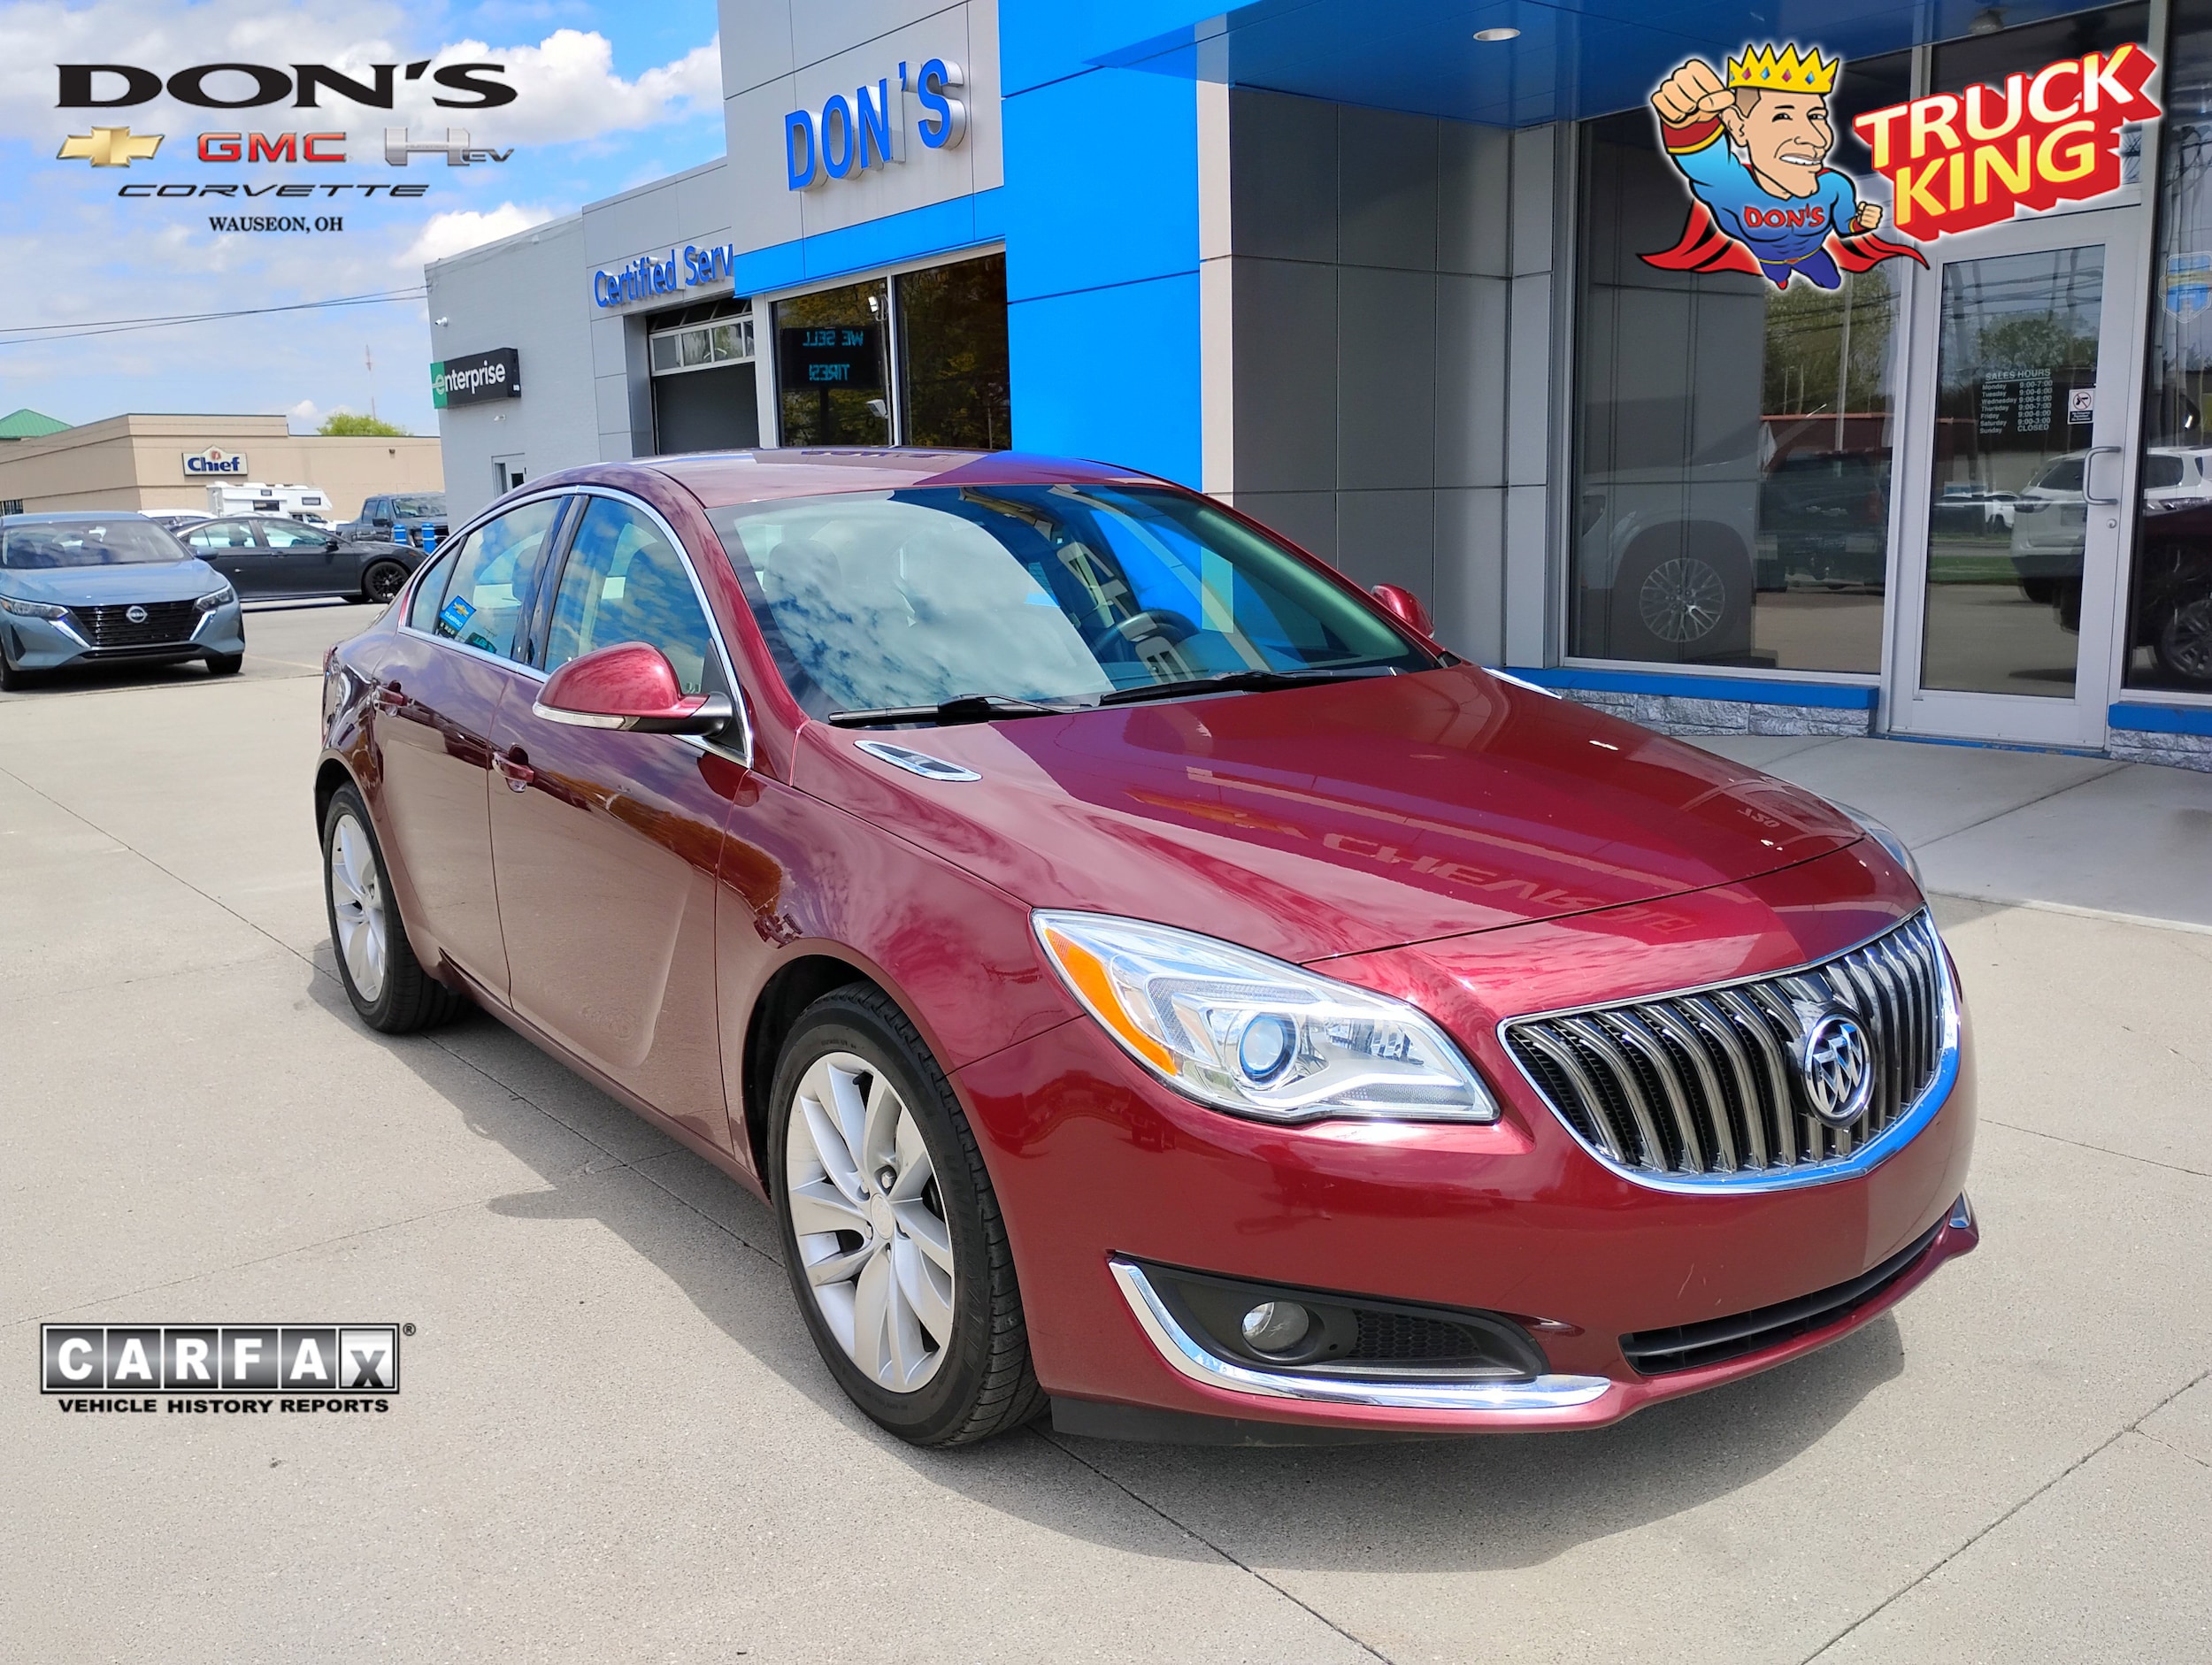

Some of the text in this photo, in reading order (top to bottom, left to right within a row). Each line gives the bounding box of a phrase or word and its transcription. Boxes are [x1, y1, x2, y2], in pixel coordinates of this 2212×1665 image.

[785, 58, 952, 191] DON'S
[594, 249, 678, 308] Certified
[432, 359, 506, 395] enterprise
[1985, 368, 2051, 381] SALES HOURS
[188, 457, 241, 472] Chief
